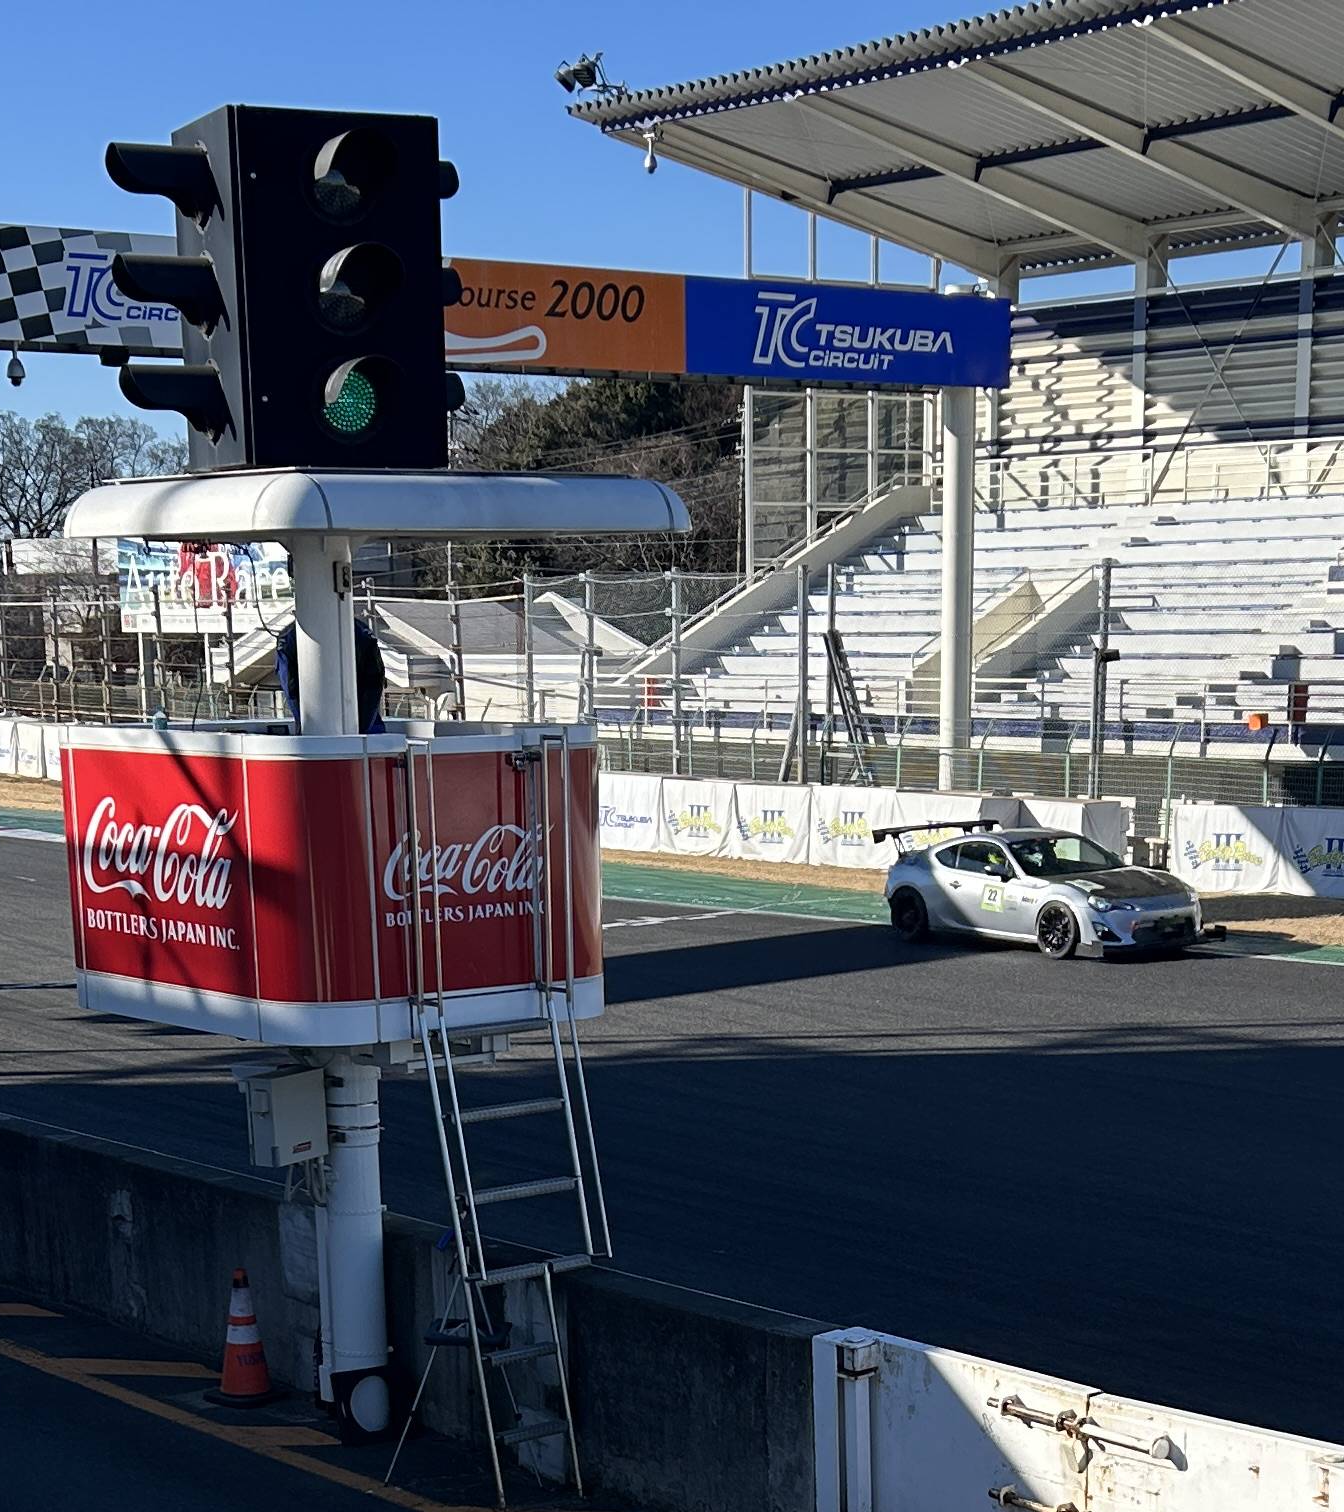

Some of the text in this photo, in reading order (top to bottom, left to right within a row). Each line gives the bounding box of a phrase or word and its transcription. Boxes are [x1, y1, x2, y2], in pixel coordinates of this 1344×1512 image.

[457, 279, 645, 323] ourse 2000
[815, 322, 954, 354] TSUKUBA
[84, 796, 239, 909] Coca-Cola
[86, 907, 240, 950] BOTTLERS JAPAN INC.
[469, 901, 514, 923] JAPAN
